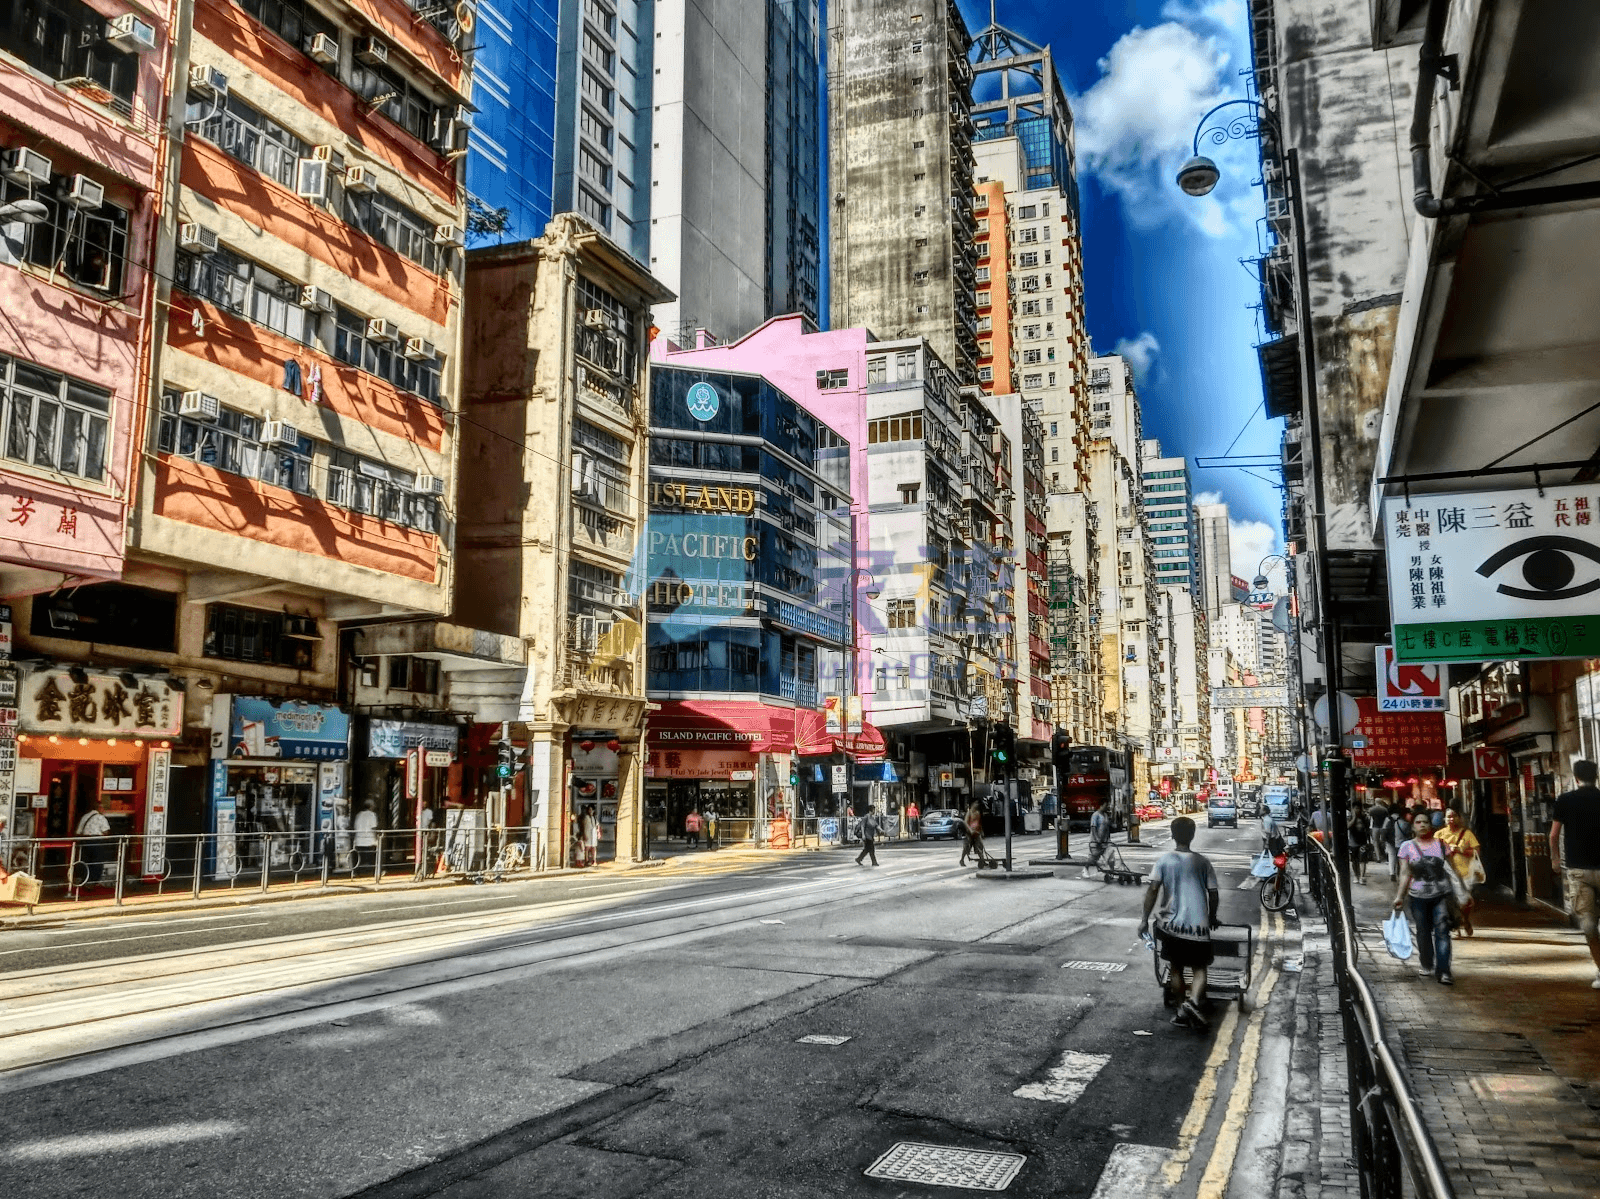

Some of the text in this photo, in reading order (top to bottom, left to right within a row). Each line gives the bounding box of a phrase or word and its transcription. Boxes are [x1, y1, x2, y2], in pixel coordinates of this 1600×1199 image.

[652, 481, 755, 515] ISLAND
[1554, 499, 1571, 527] 五代
[1574, 496, 1592, 526] 祖傳
[1395, 510, 1412, 538] 東莞
[1414, 509, 1431, 537] 中醫
[1437, 502, 1535, 534] 陳三益
[647, 530, 757, 562] PACIFIC
[1419, 540, 1431, 551] 授
[651, 580, 752, 610] HOTEL
[1409, 556, 1426, 609] 男陳祖業
[1429, 554, 1446, 609] 女陳祖華
[425, 737, 450, 748] HAIR
[660, 731, 694, 740] ISLAND
[696, 732, 732, 741] PACIFIC
[734, 733, 764, 741] HOTEL
